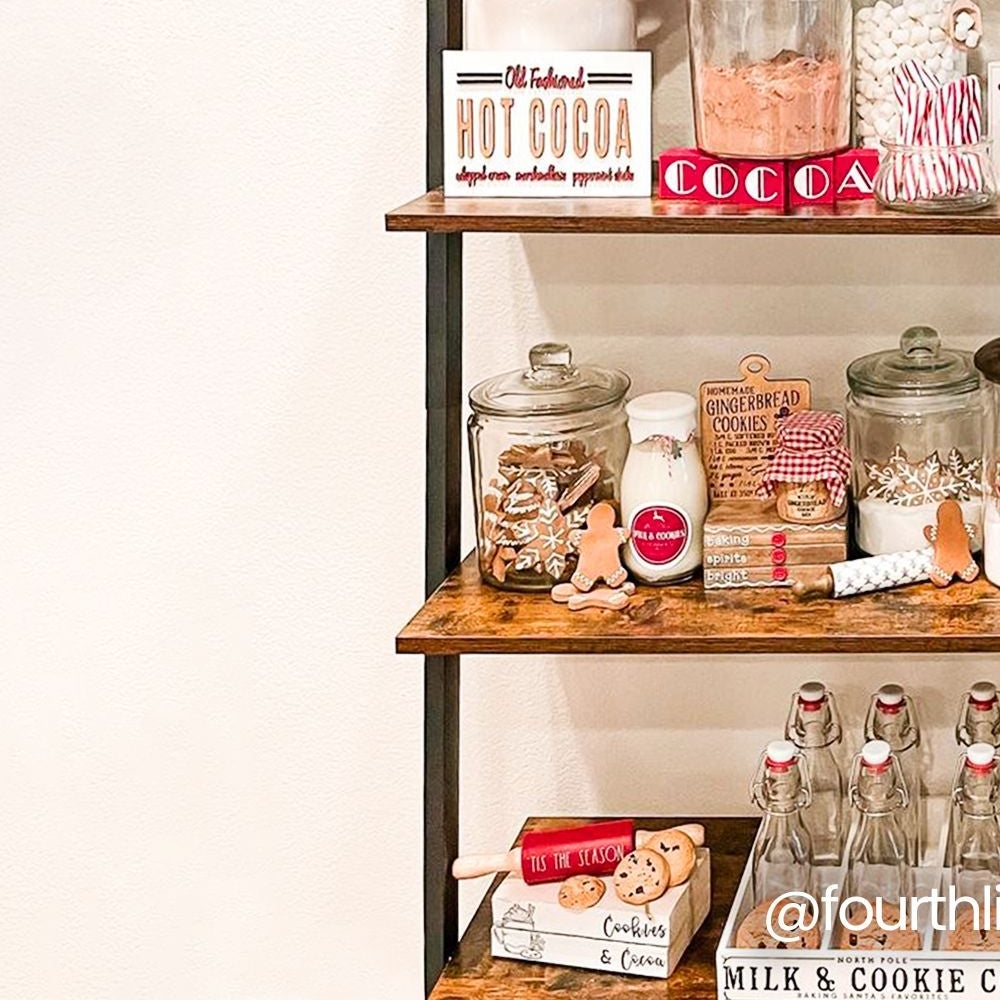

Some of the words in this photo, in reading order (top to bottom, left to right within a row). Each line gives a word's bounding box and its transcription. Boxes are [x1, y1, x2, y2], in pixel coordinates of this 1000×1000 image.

[505, 64, 528, 89] Old
[529, 66, 586, 90] Fashioned
[457, 97, 515, 159] HOT
[529, 97, 632, 159] COCOA
[706, 386, 756, 396] HOMEMADE
[706, 389, 801, 417] GINGERBREAD
[712, 414, 768, 433] COOKIES
[706, 534, 751, 548] baking
[706, 553, 749, 567] spirits
[706, 569, 750, 583] bright
[554, 852, 572, 870] THE
[578, 844, 625, 867] SEASON
[603, 914, 667, 939] Cookies
[600, 949, 612, 965] &
[621, 947, 665, 971] Cocoa
[837, 956, 874, 964] NORTH
[880, 957, 909, 965] POLE
[723, 965, 801, 992] MILK
[816, 966, 835, 992] &
[850, 966, 965, 993] COOKIE
